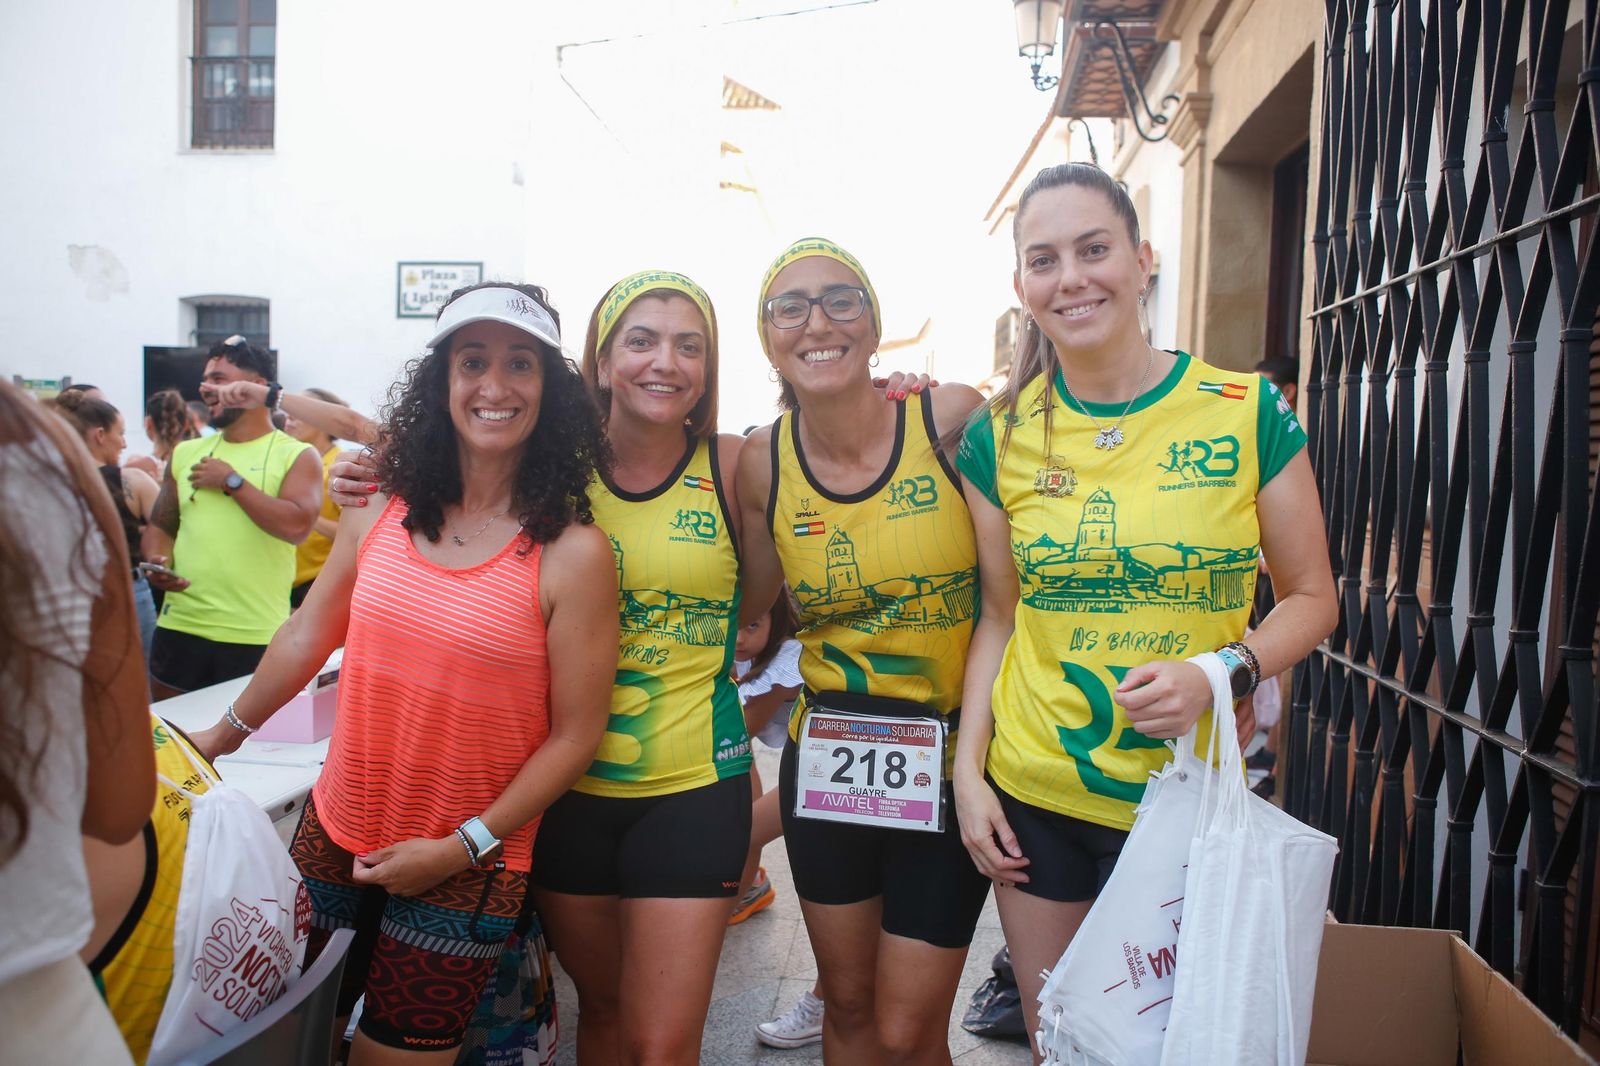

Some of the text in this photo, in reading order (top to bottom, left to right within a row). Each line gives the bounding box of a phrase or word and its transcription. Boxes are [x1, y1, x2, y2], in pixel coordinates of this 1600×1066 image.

[422, 269, 457, 280] Plaza
[1158, 479, 1237, 493] RUNNERS BARREÑOS
[795, 511, 820, 519] SMALL
[886, 511, 911, 521] RUNNERS
[668, 535, 693, 544] RUNNERS
[1069, 627, 1190, 655] LOS BARRIOS
[619, 643, 670, 665] RRIOS
[817, 720, 850, 732] CARRERA
[850, 723, 892, 735] NOCTURNA
[891, 726, 934, 739] SOLIDARIA
[830, 746, 907, 790] 218
[821, 794, 874, 811] AVATEL
[848, 786, 887, 799] GUAYRE
[258, 919, 275, 944] VI
[192, 897, 263, 993] 2024
[1122, 941, 1141, 990] LOS BARRIOS
[1132, 945, 1147, 978] VILLA DE
[213, 977, 264, 1023] SOLID
